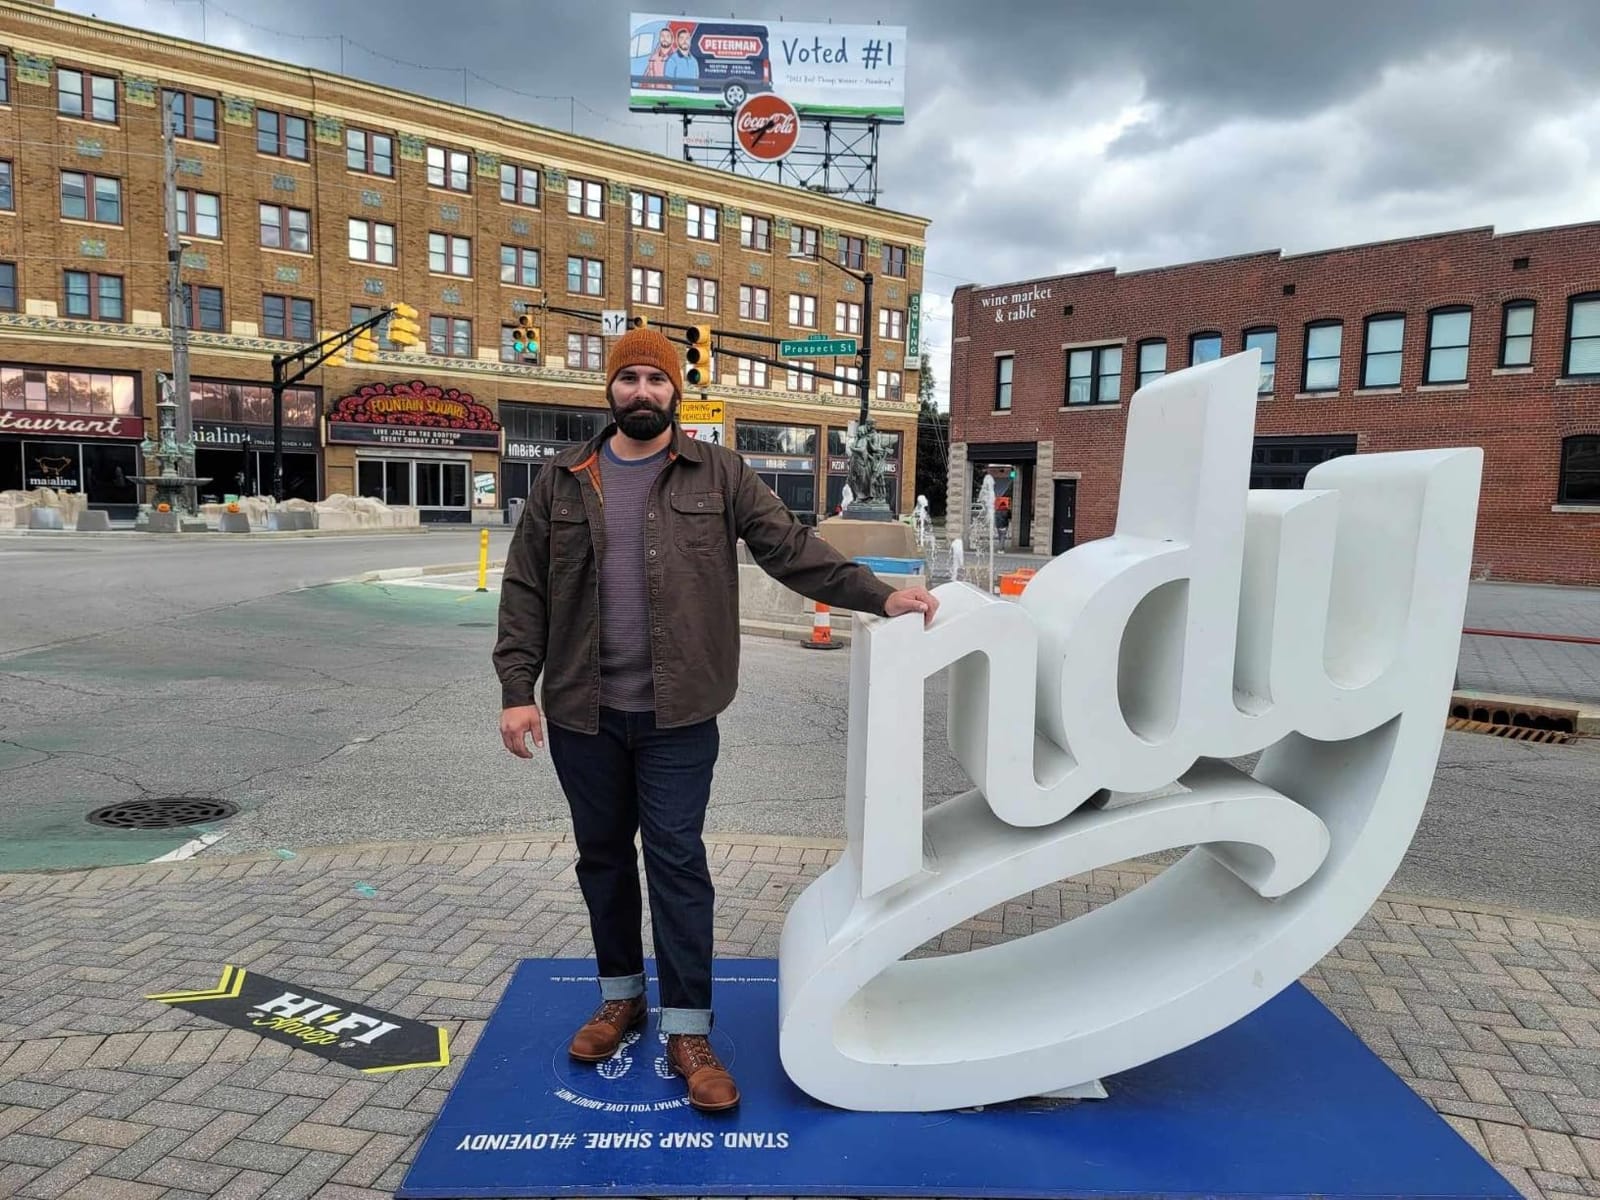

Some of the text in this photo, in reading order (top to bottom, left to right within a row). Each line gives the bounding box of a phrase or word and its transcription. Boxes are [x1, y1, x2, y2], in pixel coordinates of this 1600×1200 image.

[704, 39, 757, 52] PETERMAN
[782, 36, 892, 69] Voted #1
[981, 284, 1052, 308] wine market
[994, 303, 1037, 323] & table
[911, 296, 919, 354] BOWLING
[784, 343, 852, 353] Prospect St
[371, 398, 465, 418] FOUNTAIN SQUARE
[189, 425, 251, 444] aialina
[30, 476, 77, 487] maialina
[571, 1096, 605, 1110] ABOUT
[603, 1103, 629, 1112] LOVE
[630, 1103, 652, 1113] YOU
[653, 1100, 682, 1112] WHAT
[455, 1132, 789, 1150] STAND. SNAP. SHARE. #LOVEINDY
